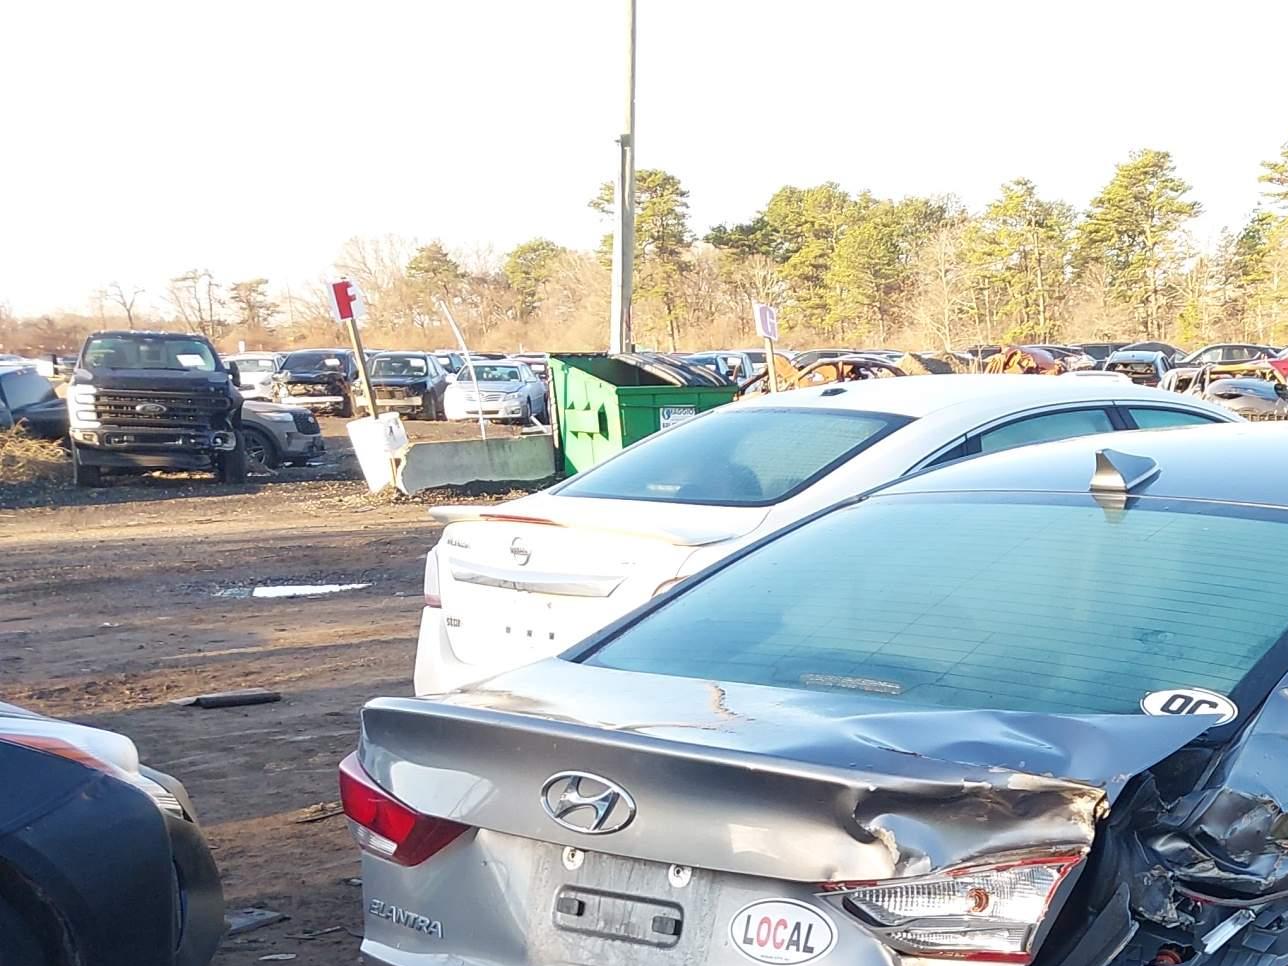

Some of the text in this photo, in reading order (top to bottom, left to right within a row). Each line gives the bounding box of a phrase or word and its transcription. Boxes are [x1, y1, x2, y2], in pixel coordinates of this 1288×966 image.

[332, 281, 356, 319] F
[369, 898, 443, 938] ELANTRA
[743, 913, 815, 953] LOCAL
